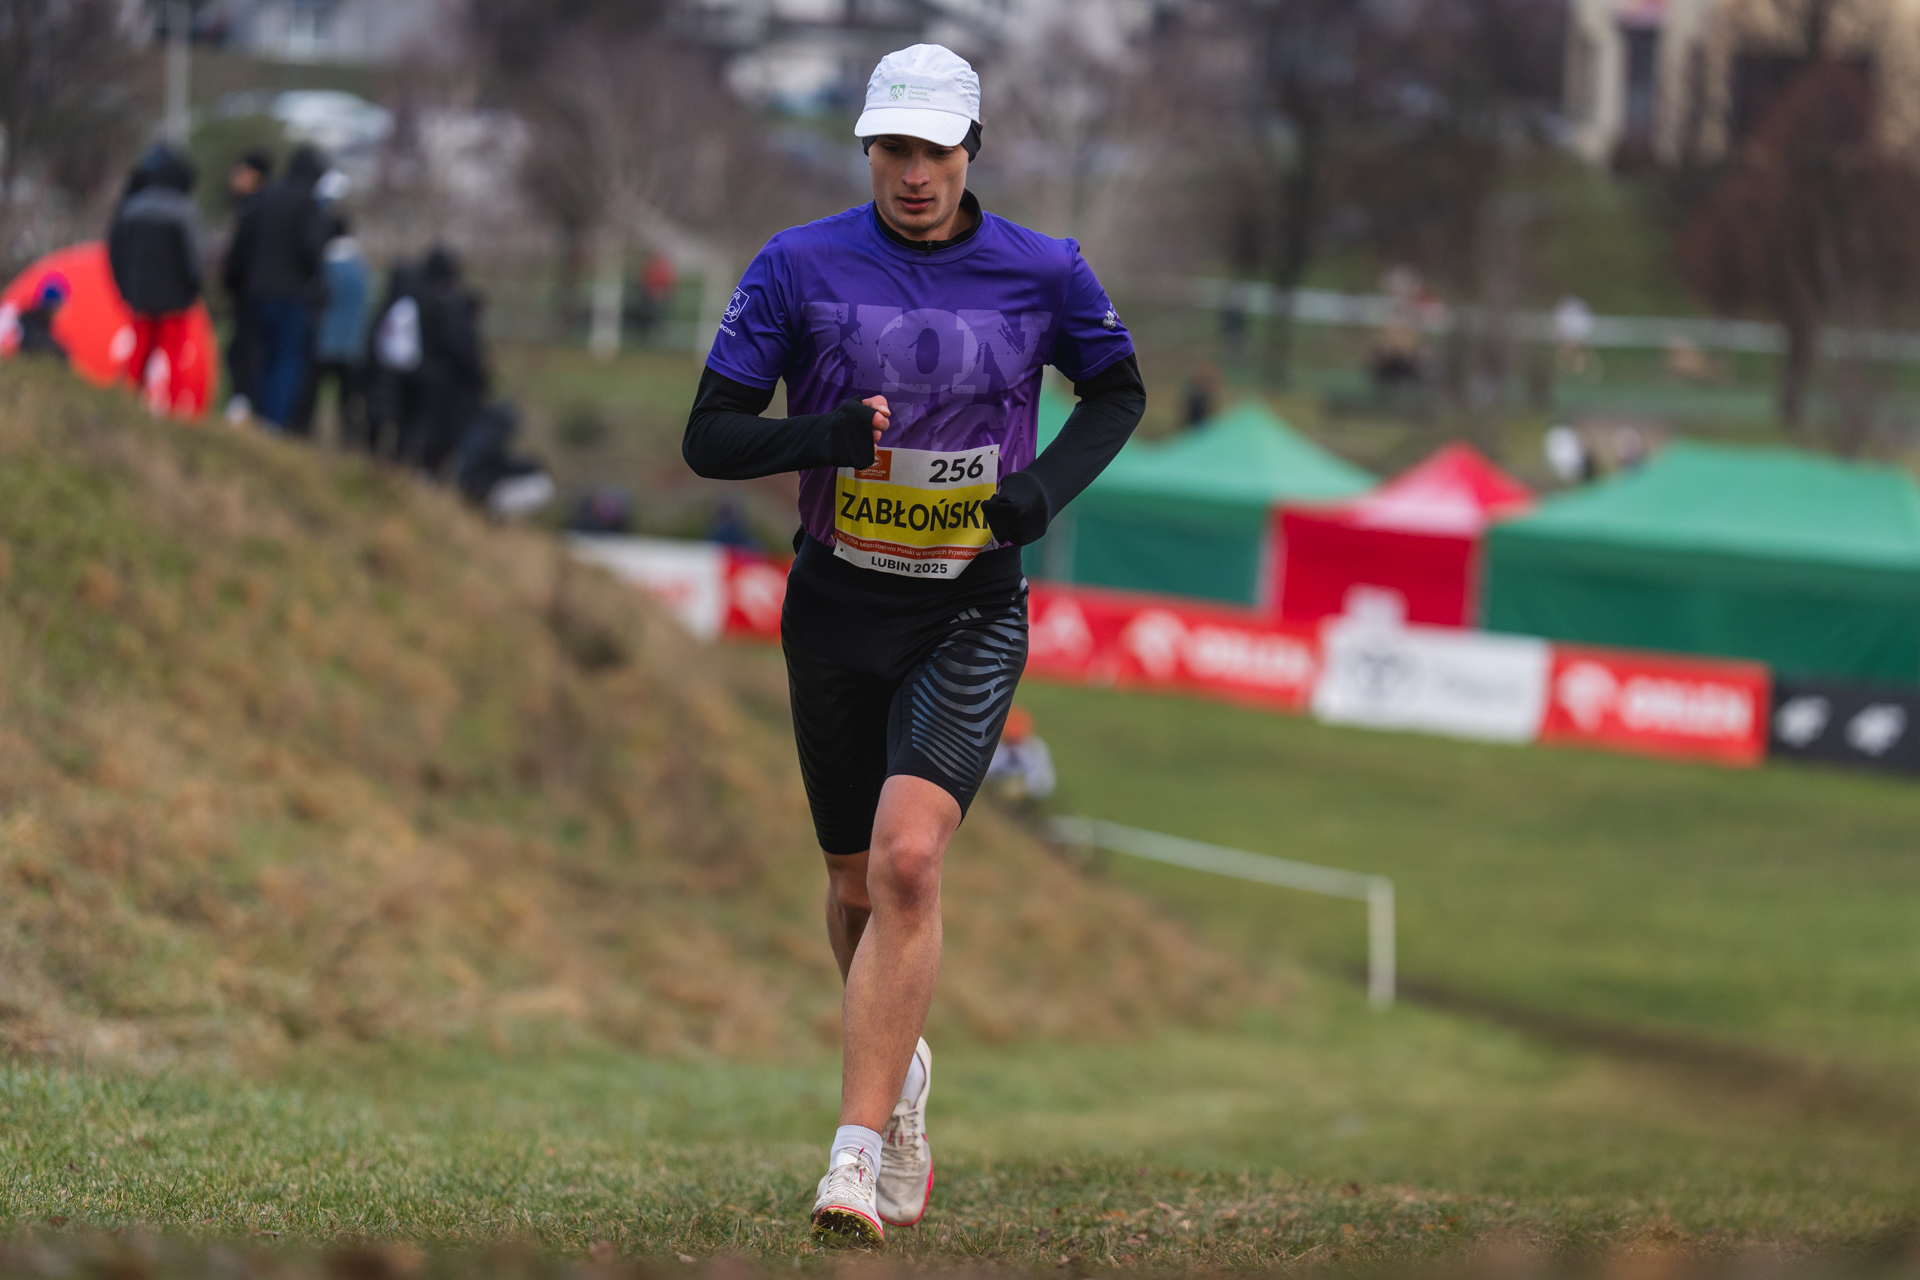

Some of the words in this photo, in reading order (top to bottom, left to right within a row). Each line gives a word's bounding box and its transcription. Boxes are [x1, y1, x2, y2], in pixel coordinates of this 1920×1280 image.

[928, 454, 984, 483] 256
[859, 542, 896, 552] Mistrzostwa
[897, 547, 915, 556] Polski
[922, 549, 947, 558] Biegach
[871, 556, 911, 573] LUBIN
[914, 563, 948, 574] 2025
